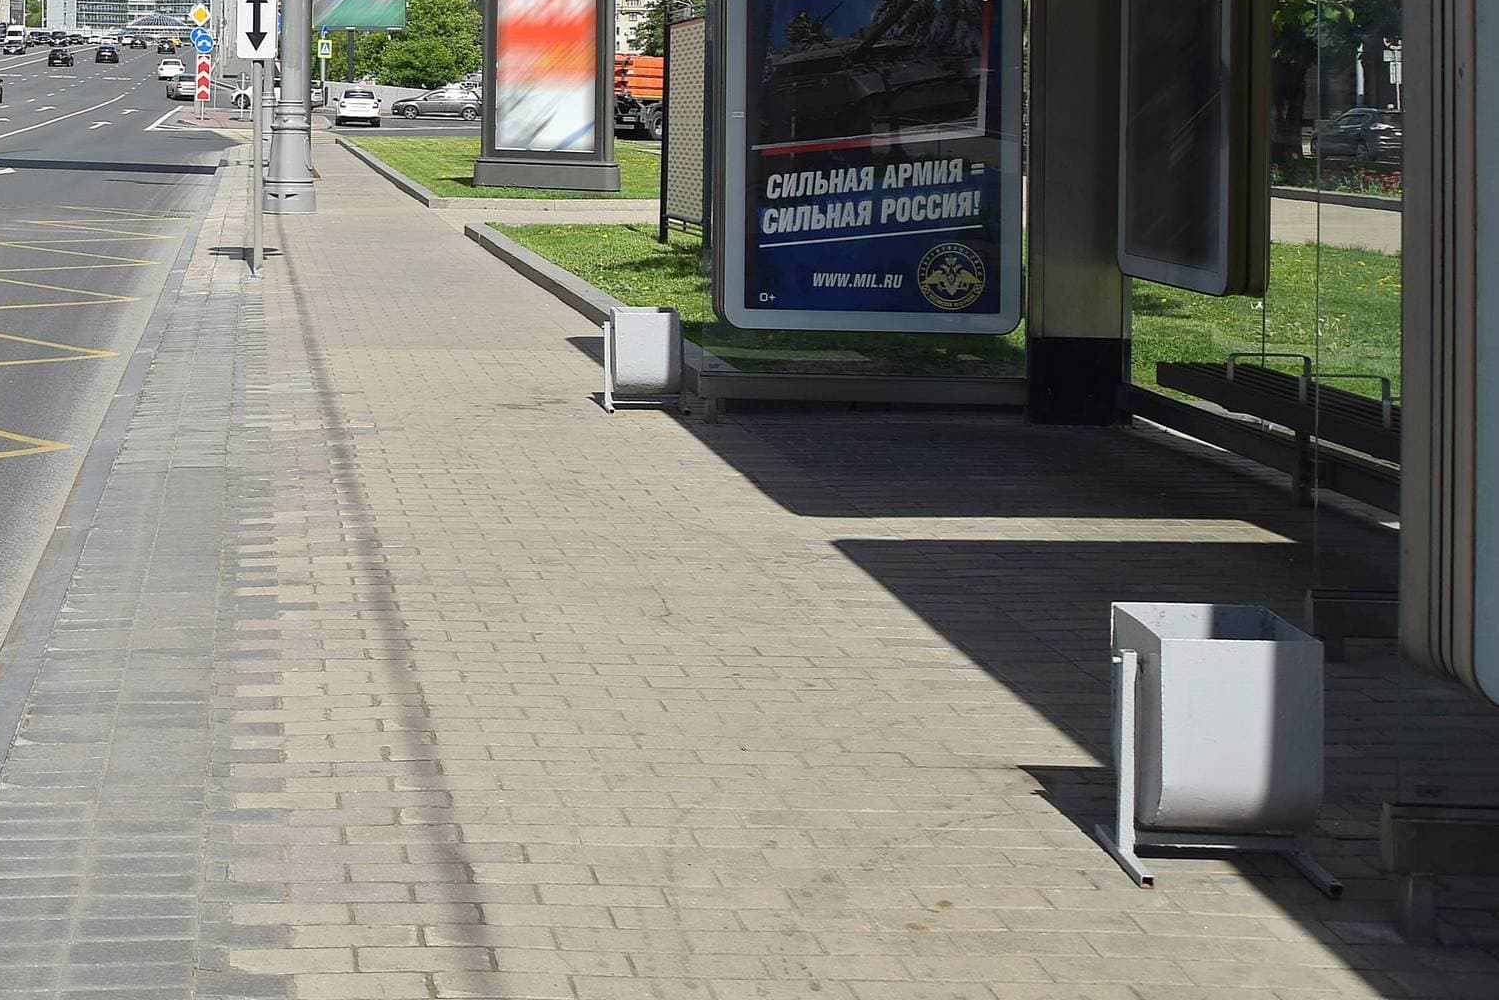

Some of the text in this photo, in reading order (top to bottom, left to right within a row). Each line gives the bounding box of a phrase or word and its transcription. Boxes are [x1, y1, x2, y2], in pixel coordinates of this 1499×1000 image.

[766, 166, 875, 199] СИЛЬНАЯ
[881, 158, 963, 189] АРМИЯ
[762, 191, 981, 234] СИЛЬНАЯ РОССИЯ!
[812, 272, 904, 289] WWW.MIL.RU
[759, 292, 776, 302] 0+
